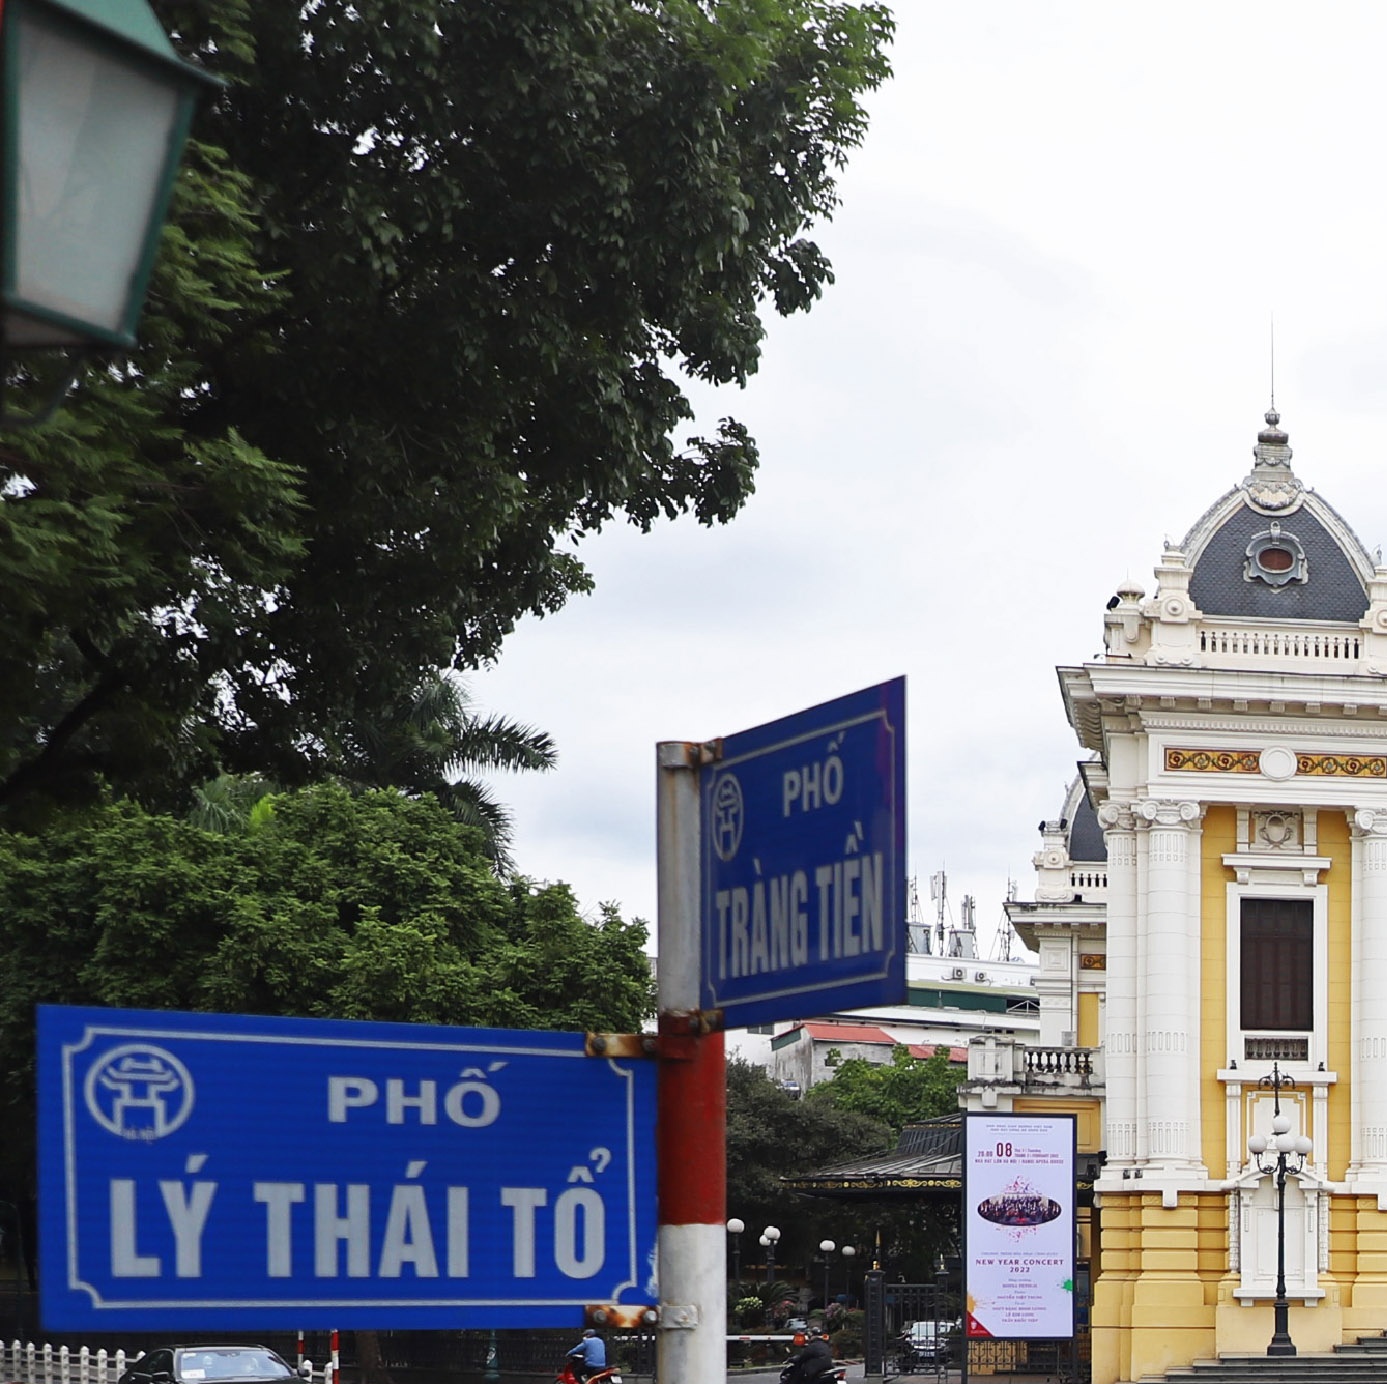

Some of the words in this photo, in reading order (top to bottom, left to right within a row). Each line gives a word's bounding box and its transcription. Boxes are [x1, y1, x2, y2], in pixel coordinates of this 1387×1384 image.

[782, 730, 844, 817] PHỐ
[716, 858, 808, 981] TRÀNG
[816, 820, 883, 961] TIỀN
[327, 1062, 509, 1128] PHỐ
[996, 1142, 1013, 1158] 08
[110, 1154, 218, 1278] LÝ
[253, 1160, 469, 1279] THÁI
[501, 1147, 611, 1280] TỔ
